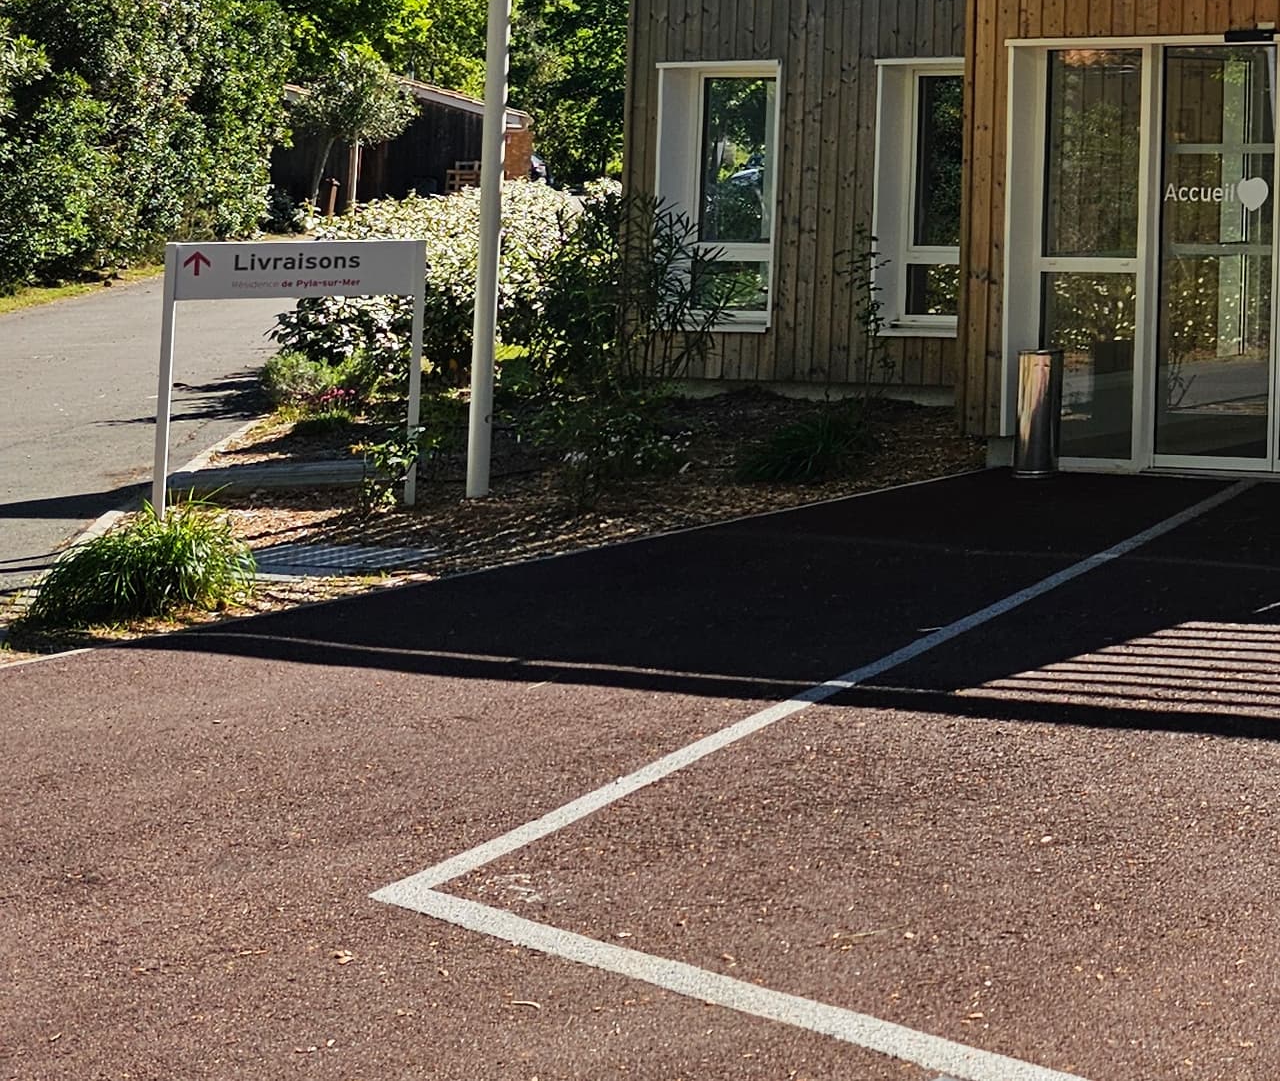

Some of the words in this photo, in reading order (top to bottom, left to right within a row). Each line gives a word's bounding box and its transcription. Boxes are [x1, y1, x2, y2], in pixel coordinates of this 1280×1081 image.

[1164, 182, 1236, 202] Accueil
[234, 253, 360, 271] Livraisons
[282, 279, 292, 288] de
[296, 279, 360, 288] Pyla-sur-Mer
